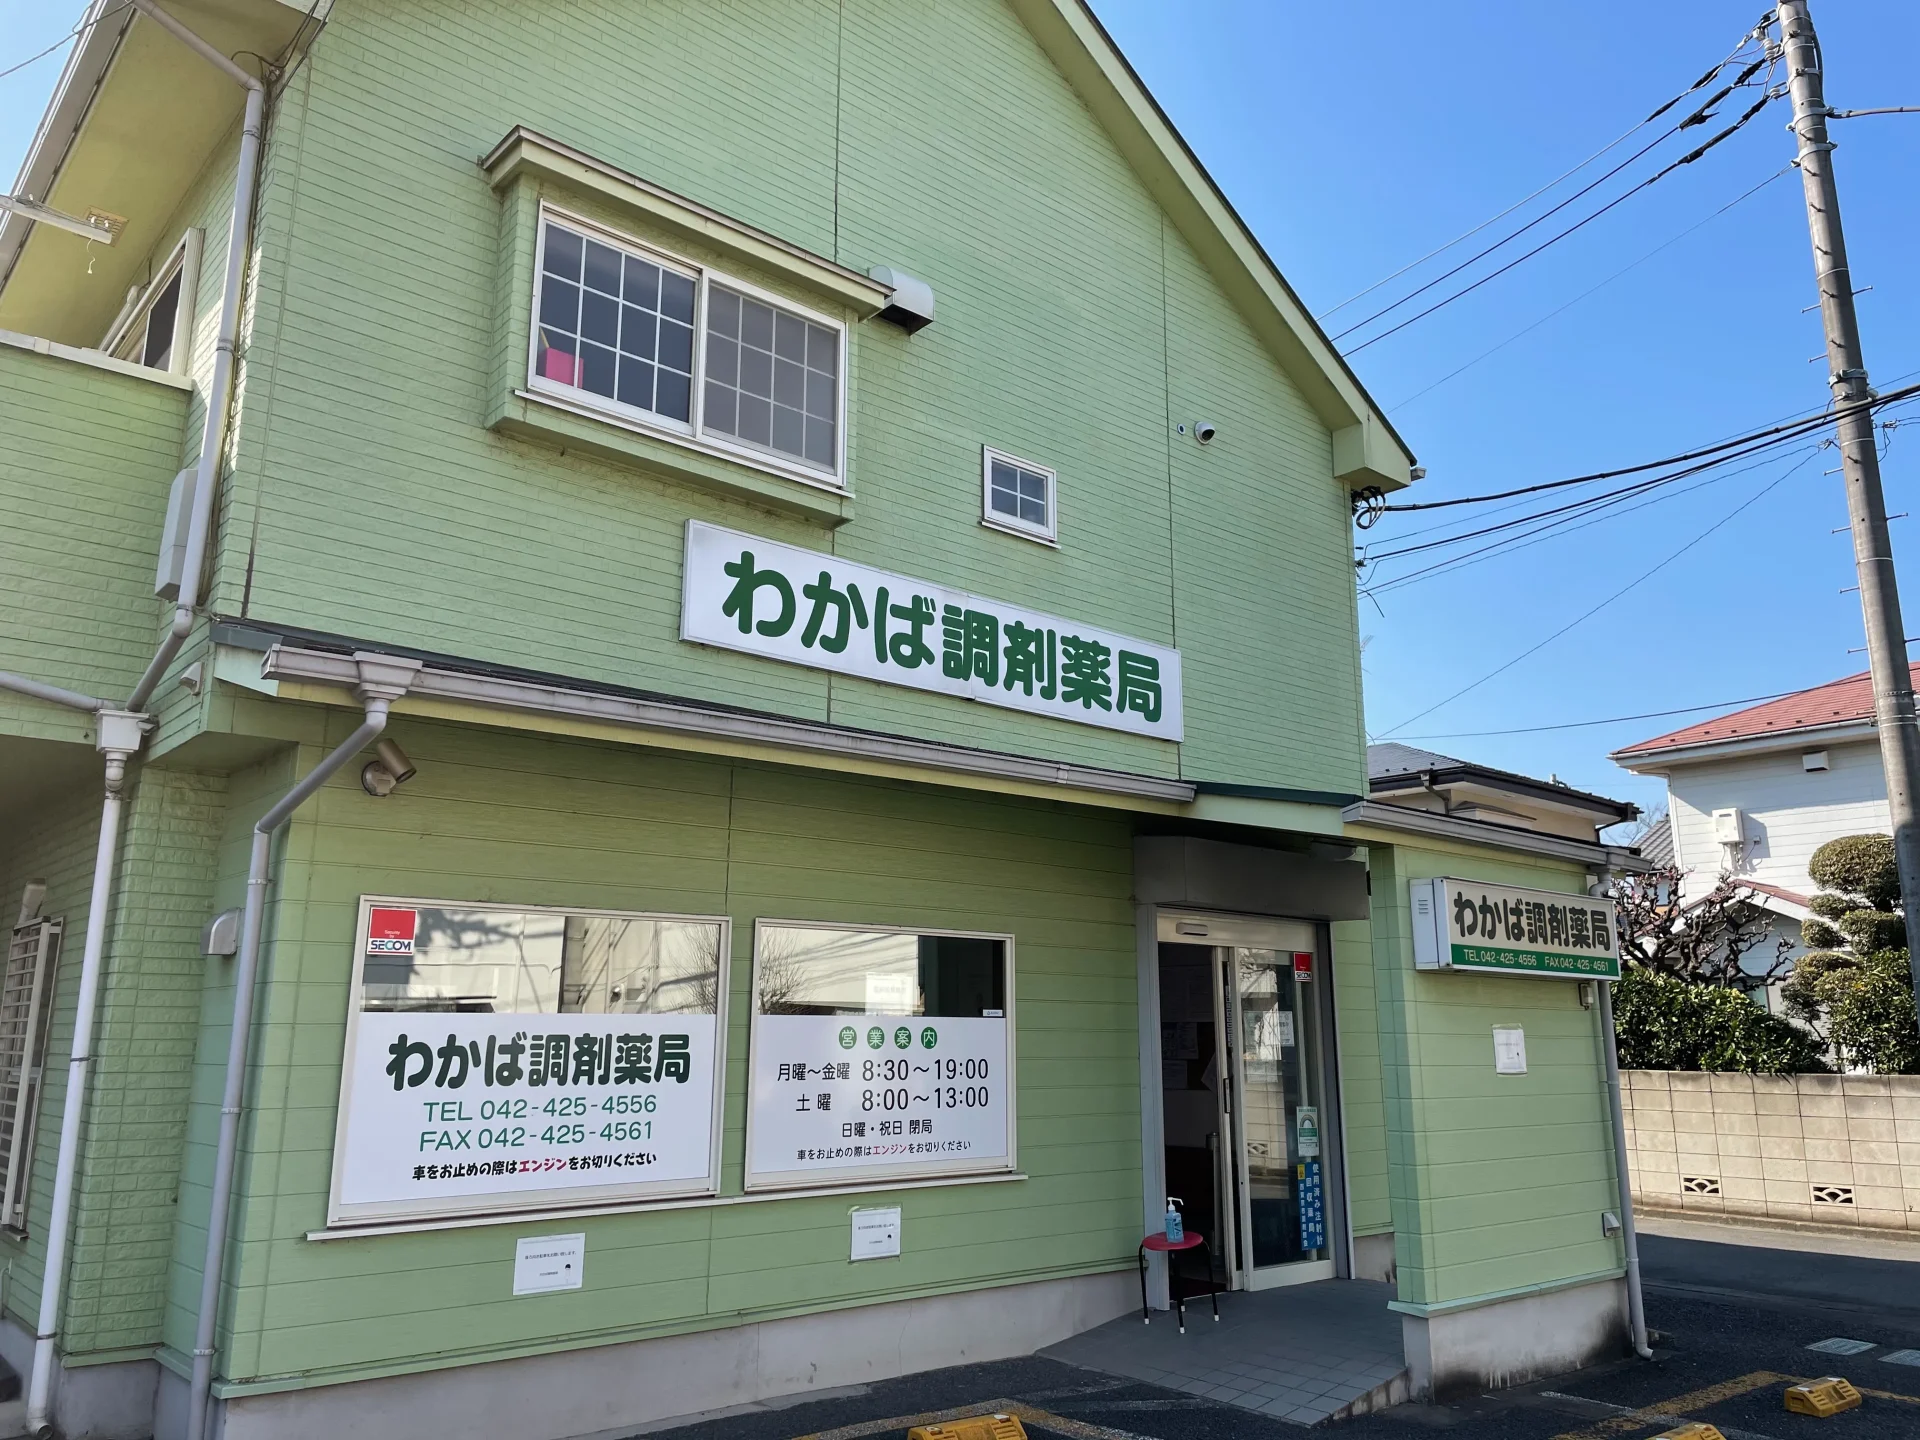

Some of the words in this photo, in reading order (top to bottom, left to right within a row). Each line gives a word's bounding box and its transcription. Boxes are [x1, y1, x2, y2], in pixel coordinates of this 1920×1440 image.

[722, 550, 1162, 723] わかば調剤薬局
[1453, 891, 1611, 951] わかば調剤薬局
[370, 939, 412, 952] SECOM
[1463, 948, 1480, 962] TEL
[1480, 950, 1537, 966] 042-425-4556
[1544, 956, 1560, 968] FAX
[1559, 957, 1609, 972] 042-425-4561
[840, 1028, 936, 1048] 営業案内
[386, 1032, 691, 1092] わかば調剤薬局
[423, 1101, 473, 1123] TEL
[480, 1094, 657, 1121] 042-425-4556
[419, 1129, 472, 1152] FAX
[478, 1117, 653, 1149] 042-425-4561
[909, 1119, 933, 1135] 閉局
[796, 1140, 971, 1161] 車をお止めの際はエンジンをお切りください
[412, 1152, 657, 1181] 車をお止めの際はエンジンをお切りください
[1312, 1163, 1323, 1246] 使用済み注射針
